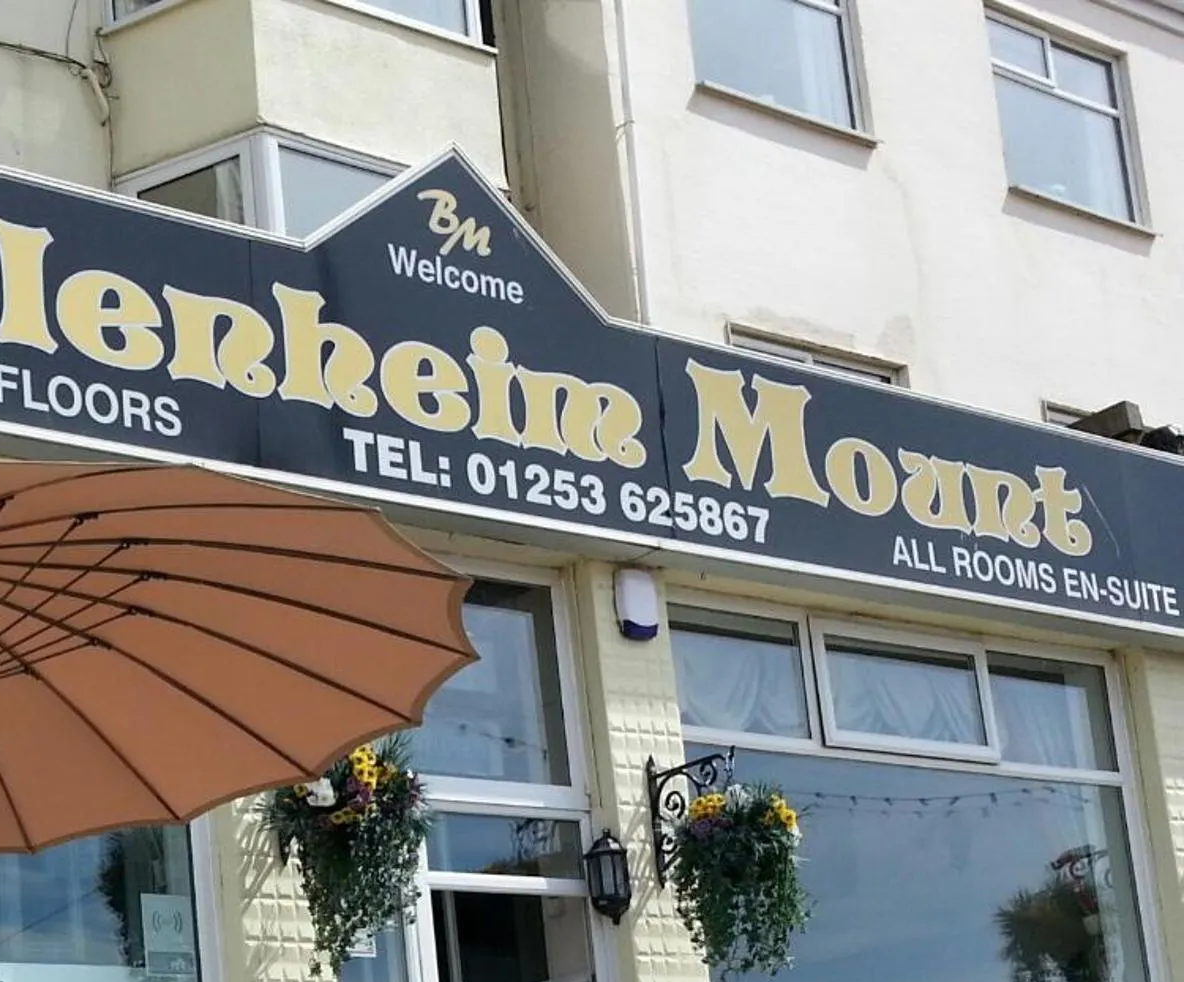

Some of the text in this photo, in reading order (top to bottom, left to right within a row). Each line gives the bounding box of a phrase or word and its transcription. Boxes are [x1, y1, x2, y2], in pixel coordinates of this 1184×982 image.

[388, 243, 524, 304] Welcome
[343, 428, 770, 545] TEL: 01253 625867
[682, 357, 1092, 557] Mount
[892, 535, 1181, 617] ALL ROOMS EN-SUITE
